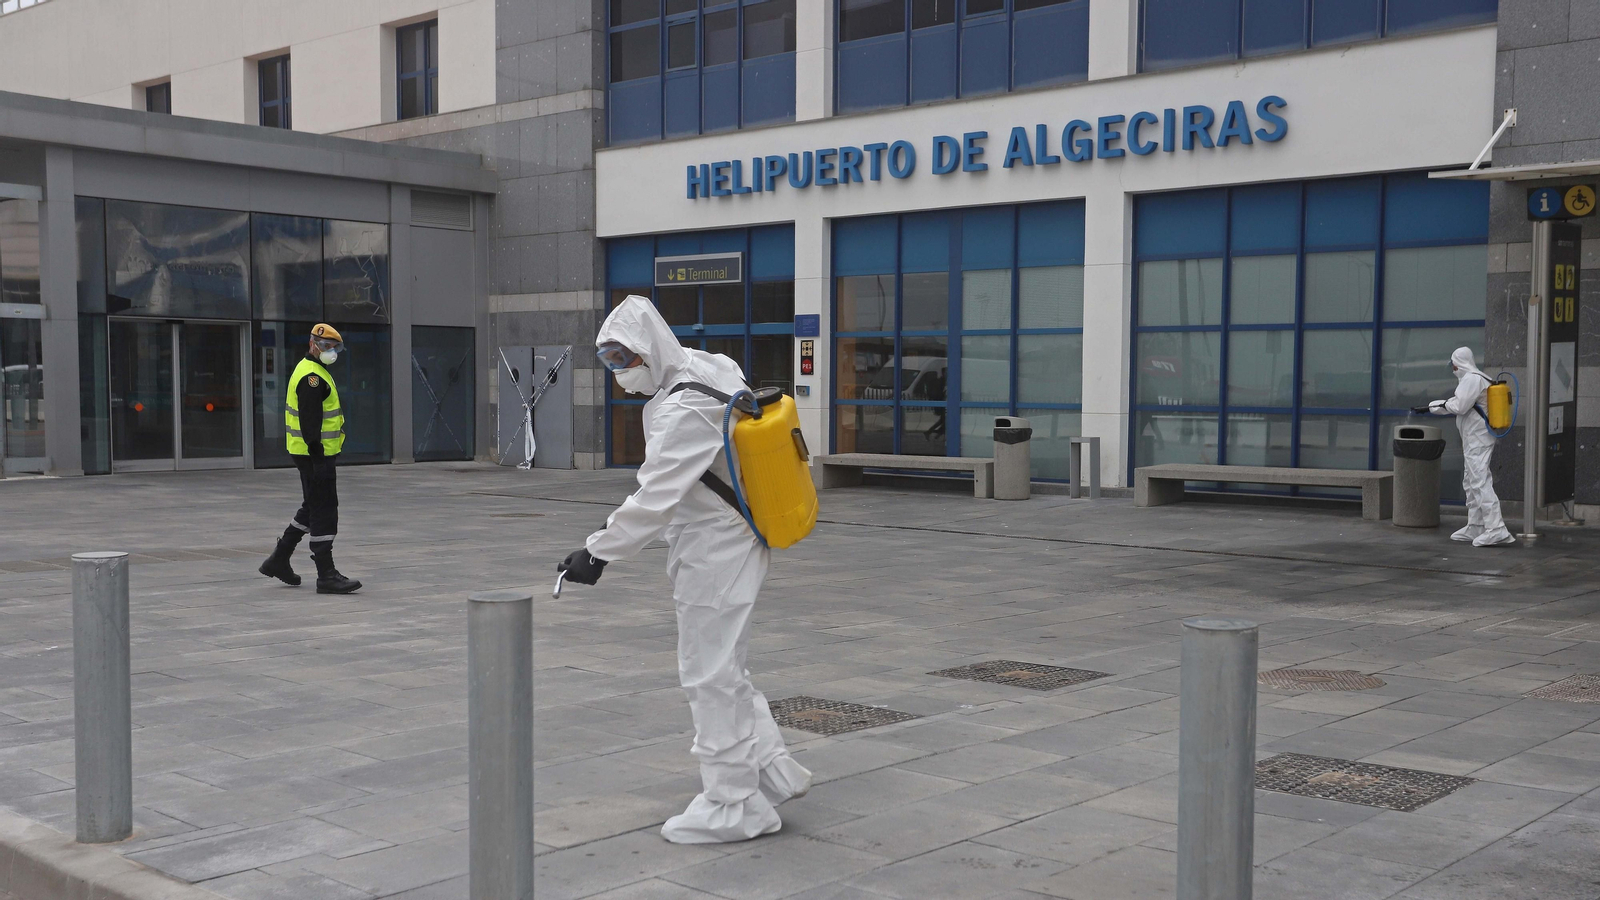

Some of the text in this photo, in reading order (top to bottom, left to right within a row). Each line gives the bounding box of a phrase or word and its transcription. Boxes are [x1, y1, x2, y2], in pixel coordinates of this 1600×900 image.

[686, 95, 1289, 200] HELIPUERTO DE ALGECIRAS
[1540, 192, 1550, 212] i
[688, 266, 728, 281] Terminal
